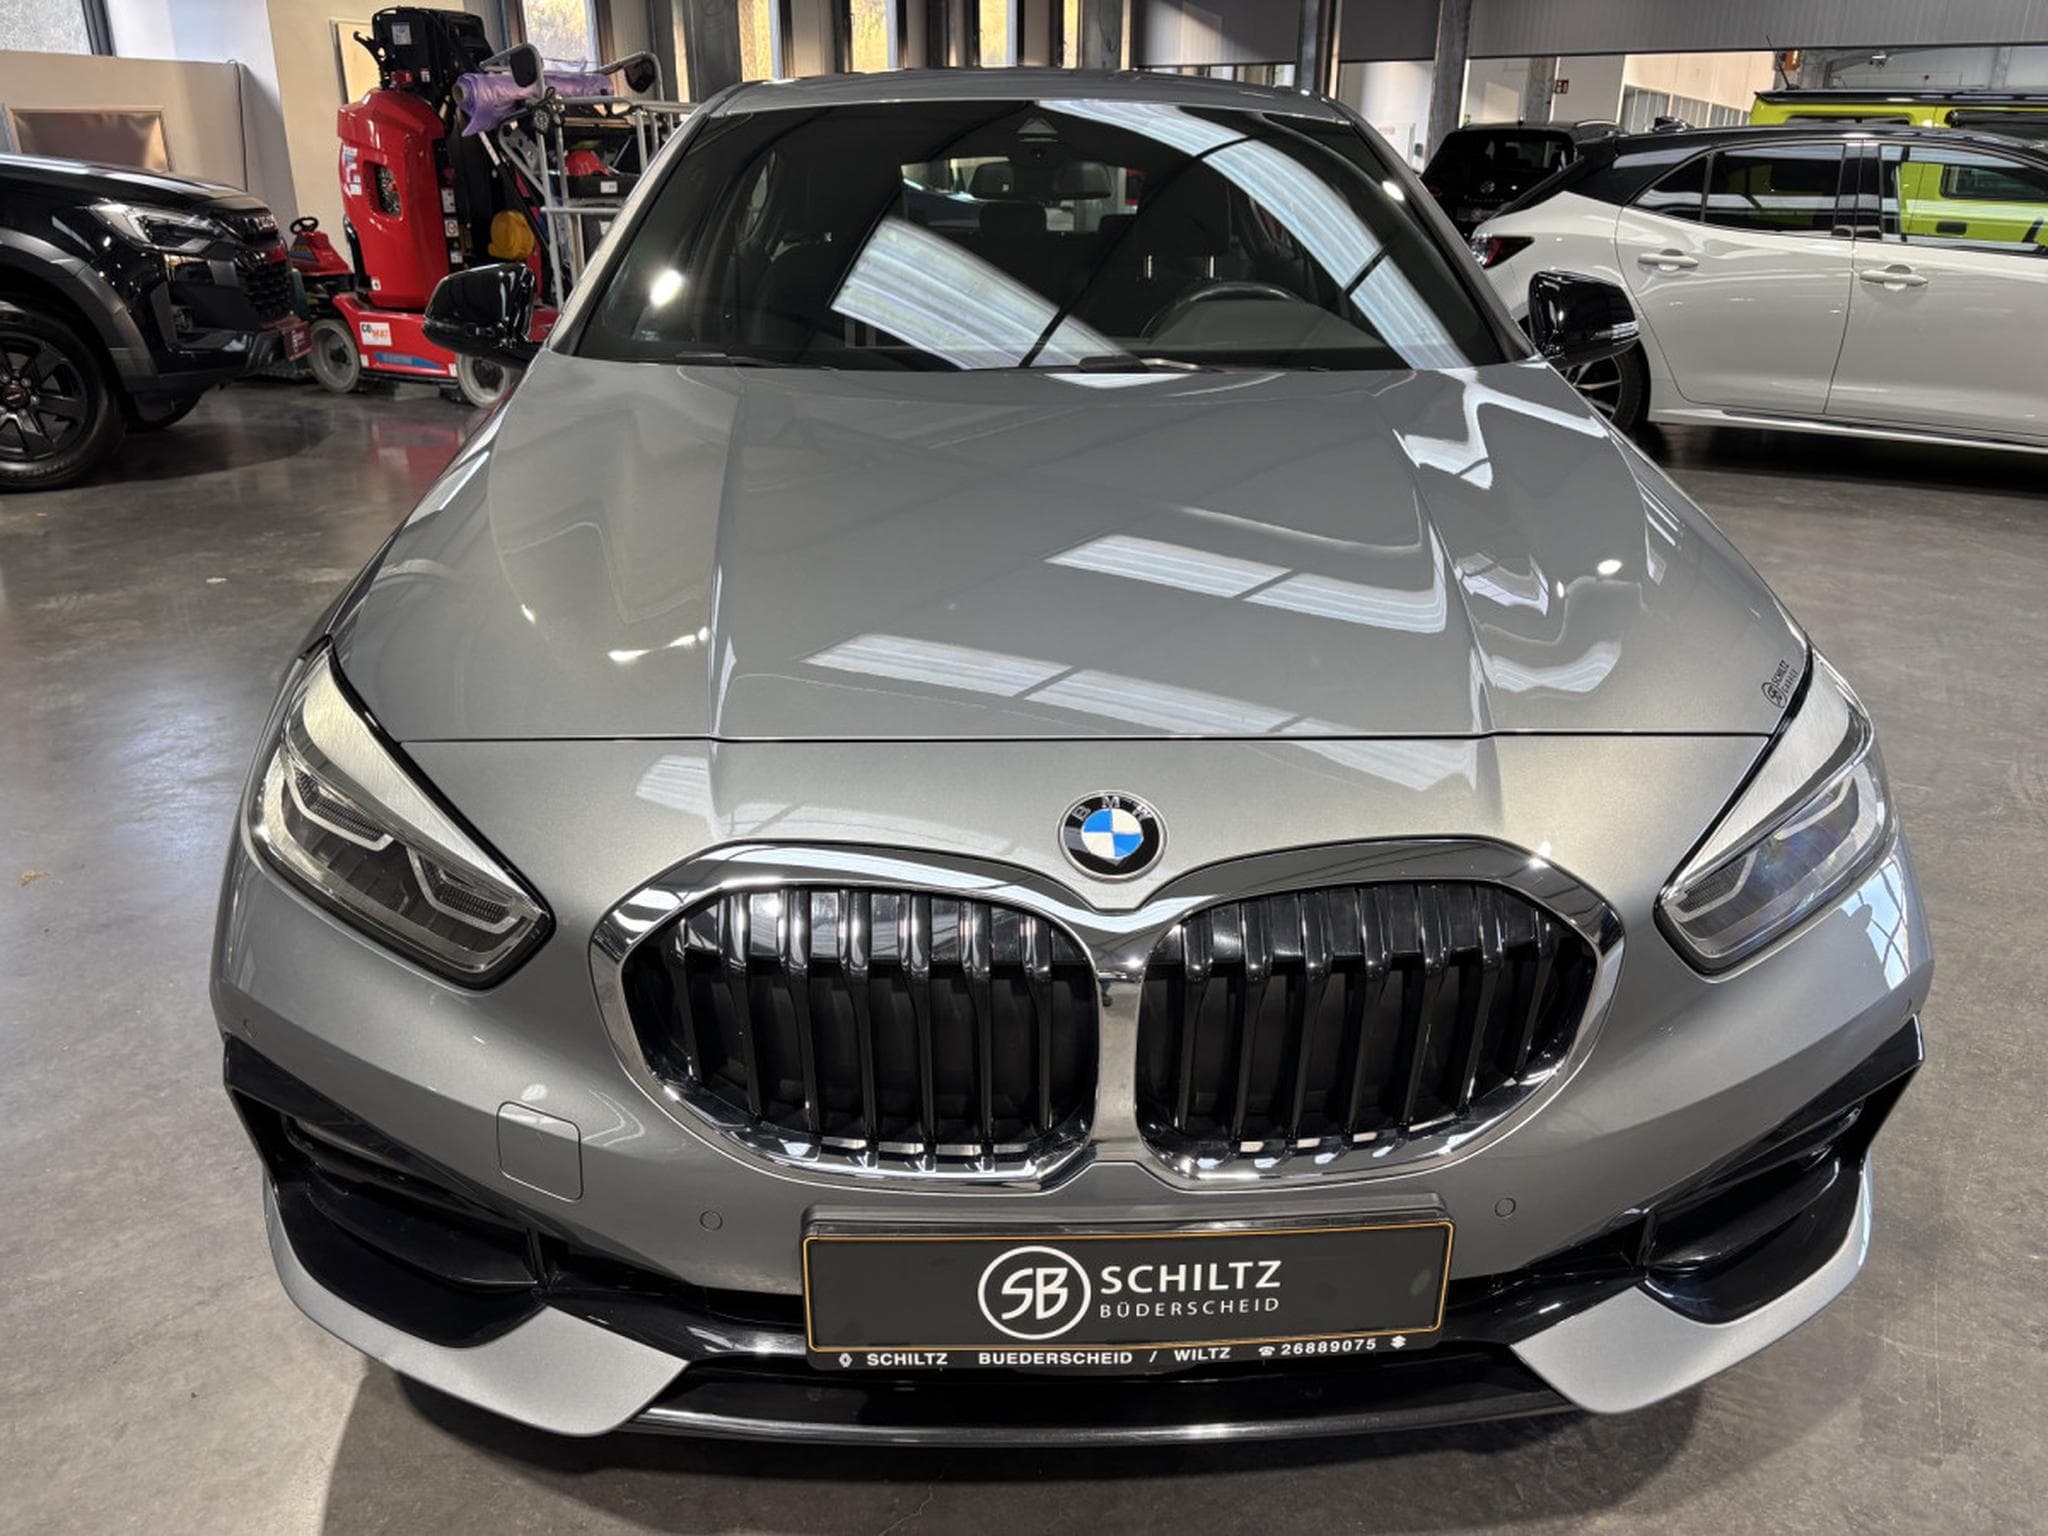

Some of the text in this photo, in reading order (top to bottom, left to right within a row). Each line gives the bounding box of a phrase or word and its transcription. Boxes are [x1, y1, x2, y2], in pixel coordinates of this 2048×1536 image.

[1071, 796, 1153, 821] BMW
[1100, 1260, 1282, 1295] SCHILTZ
[1099, 1297, 1280, 1319] BÜDERSCHEID
[866, 1352, 949, 1366] SCHILTZ
[978, 1351, 1133, 1366] BUEDERSCHEID
[1174, 1346, 1232, 1361] WILTZ
[1280, 1338, 1377, 1356] 26889075
